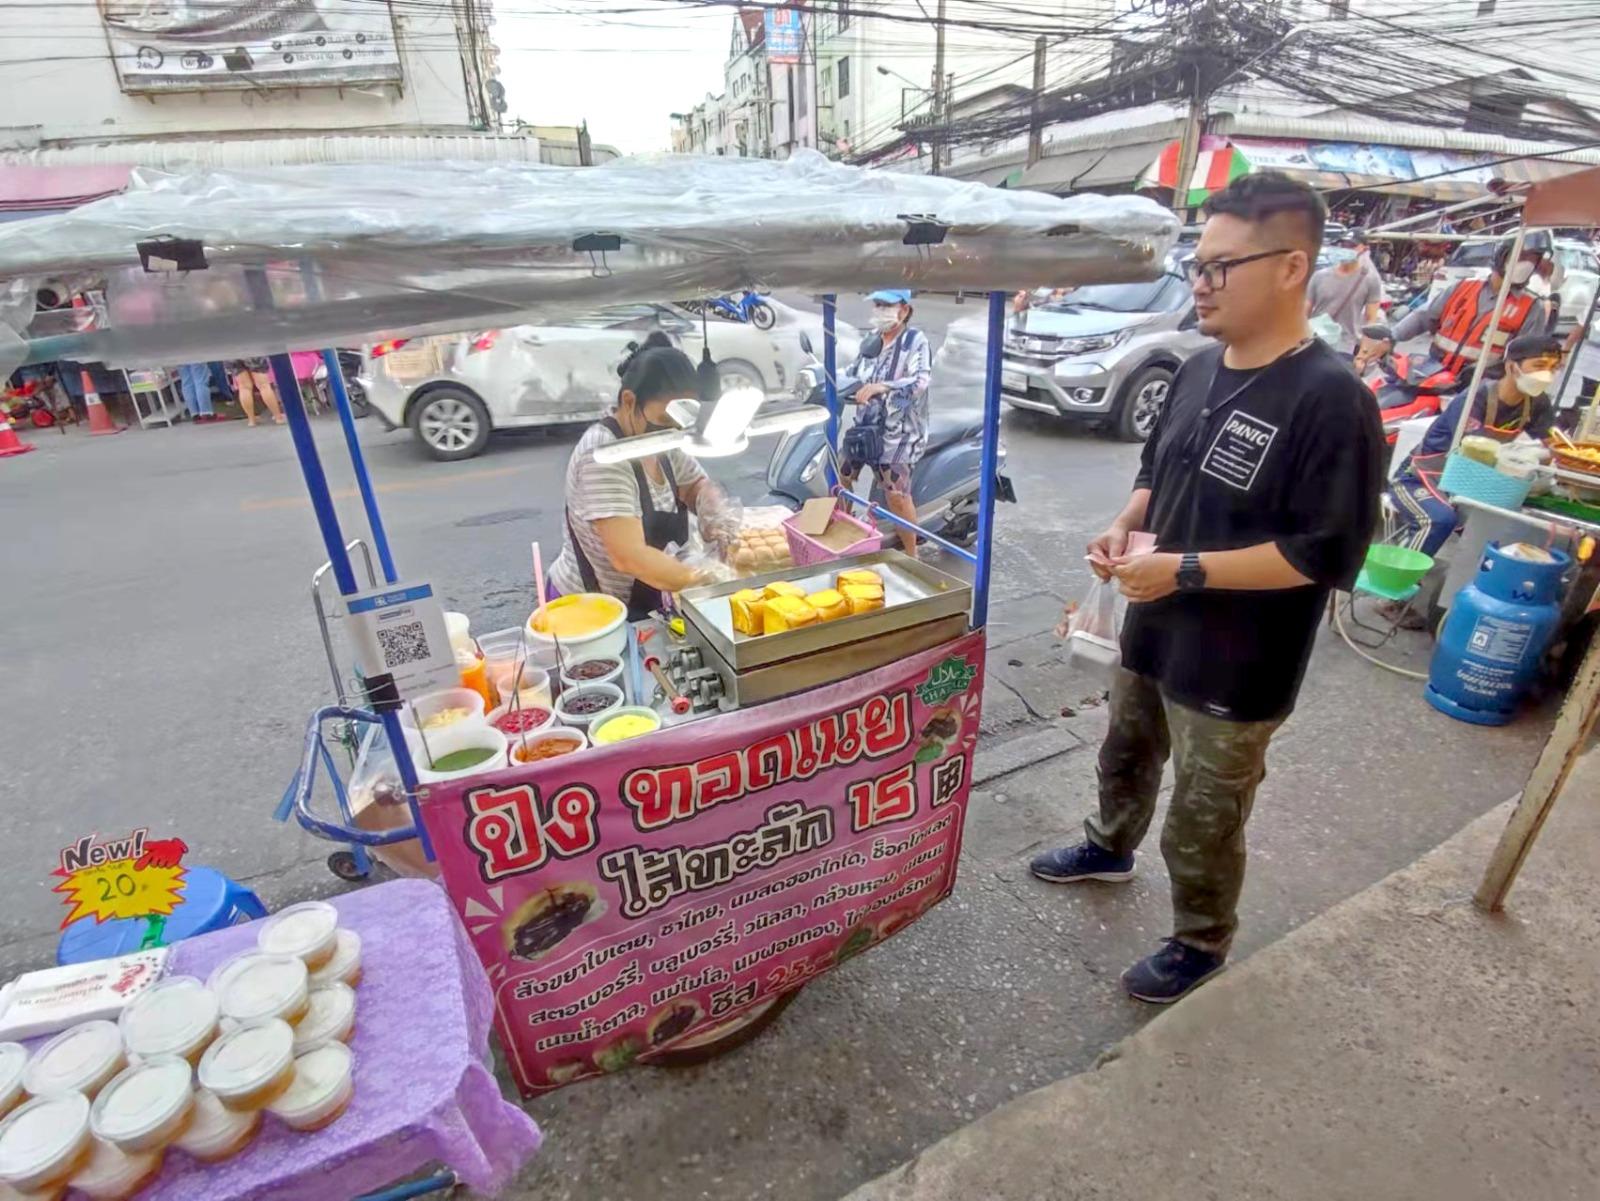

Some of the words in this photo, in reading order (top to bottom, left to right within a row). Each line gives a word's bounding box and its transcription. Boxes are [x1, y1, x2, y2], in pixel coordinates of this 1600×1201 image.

[1226, 419, 1270, 446] PANIC
[469, 784, 597, 880] ปัง
[623, 692, 911, 828] ทอดเนย
[62, 828, 149, 873] New!
[601, 803, 831, 915] ไส้ทะลัก
[849, 766, 916, 831] 15
[661, 905, 724, 937] ชาไทย,
[536, 1003, 646, 1052] เนยน้ำตาล,
[651, 966, 729, 1005] นมไมโล,
[734, 921, 841, 974] นมฝอยทอง,
[711, 979, 757, 1017] ชีส
